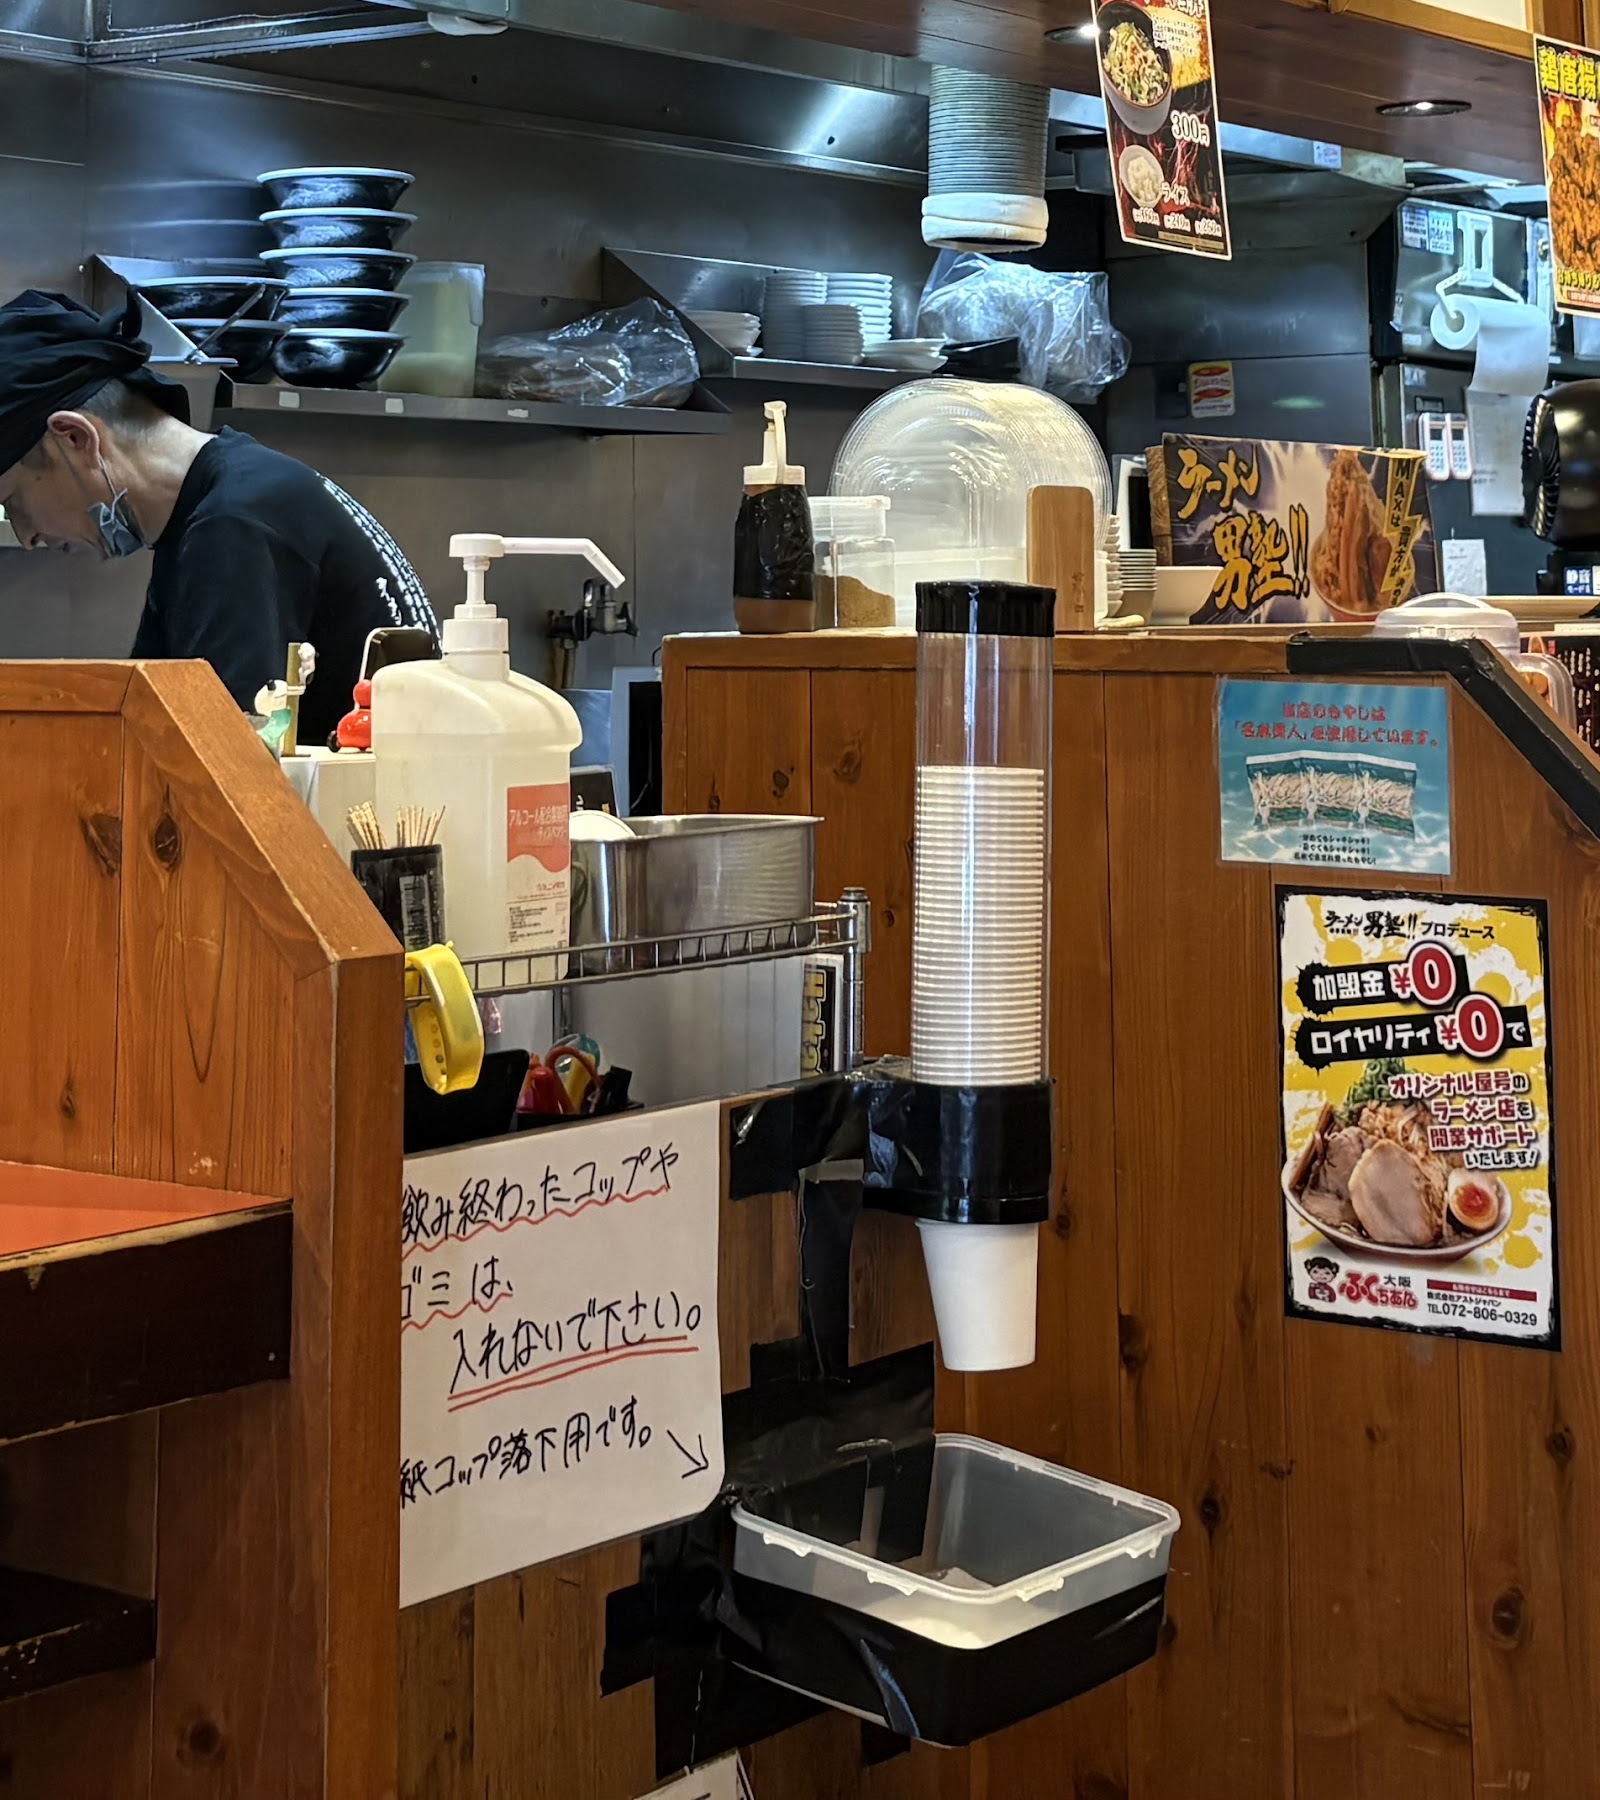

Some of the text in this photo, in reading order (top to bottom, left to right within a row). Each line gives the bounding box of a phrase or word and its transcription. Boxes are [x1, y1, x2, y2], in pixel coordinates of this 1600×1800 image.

[1177, 443, 1259, 520] ラーメン
[1312, 969, 1385, 1001] 加盟金
[1311, 1022, 1431, 1055] ロイヤリティ
[1433, 1098, 1532, 1121] ラーメン店を
[1429, 1124, 1534, 1149] 開業サポート
[1383, 1274, 1412, 1288] 大阪
[448, 1291, 701, 1395] 入れないで下さい。
